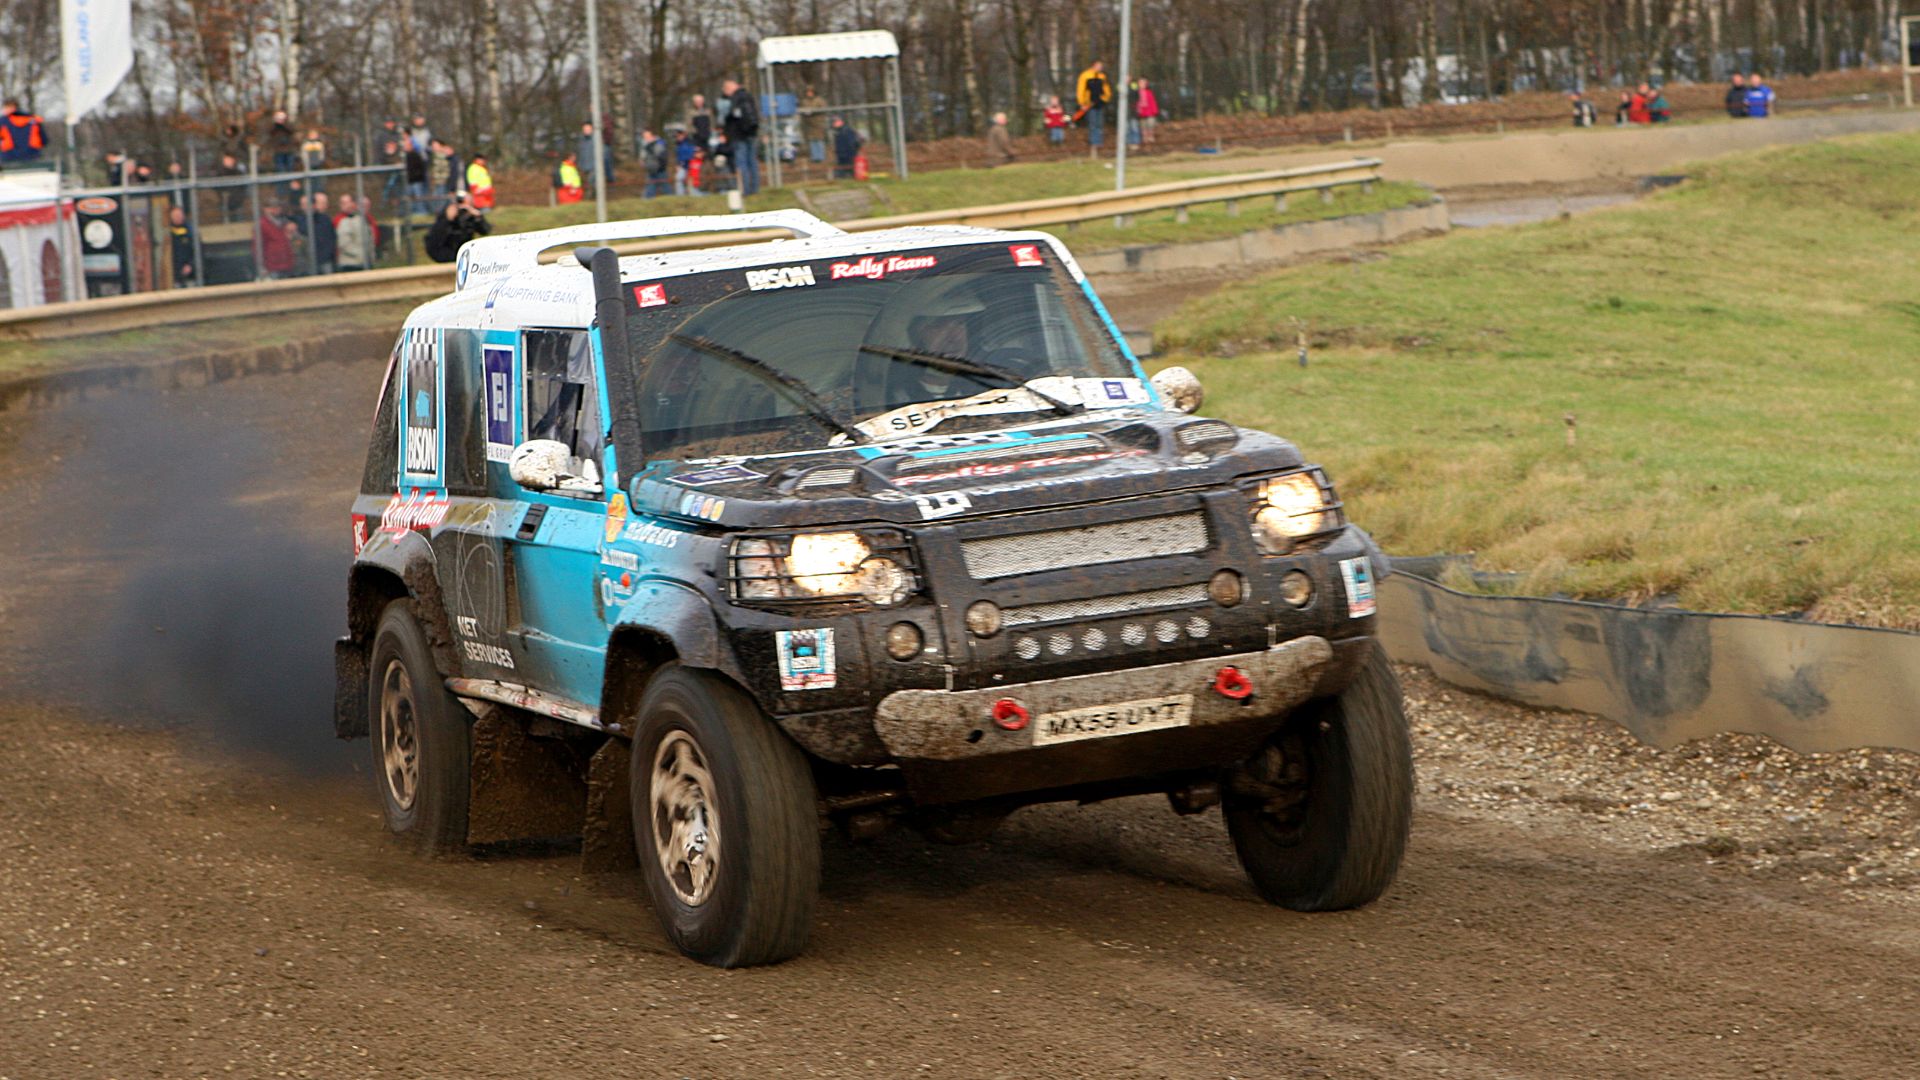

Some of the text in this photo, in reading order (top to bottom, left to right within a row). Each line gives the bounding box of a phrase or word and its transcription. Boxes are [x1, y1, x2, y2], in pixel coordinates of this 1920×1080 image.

[470, 261, 510, 275] Diesel Power
[746, 254, 935, 291] BISON Rally Team
[499, 286, 582, 305] KAUPTHING BANK
[408, 427, 437, 471] BISON
[380, 490, 450, 541] Rally Team
[463, 640, 515, 670] SERVICES
